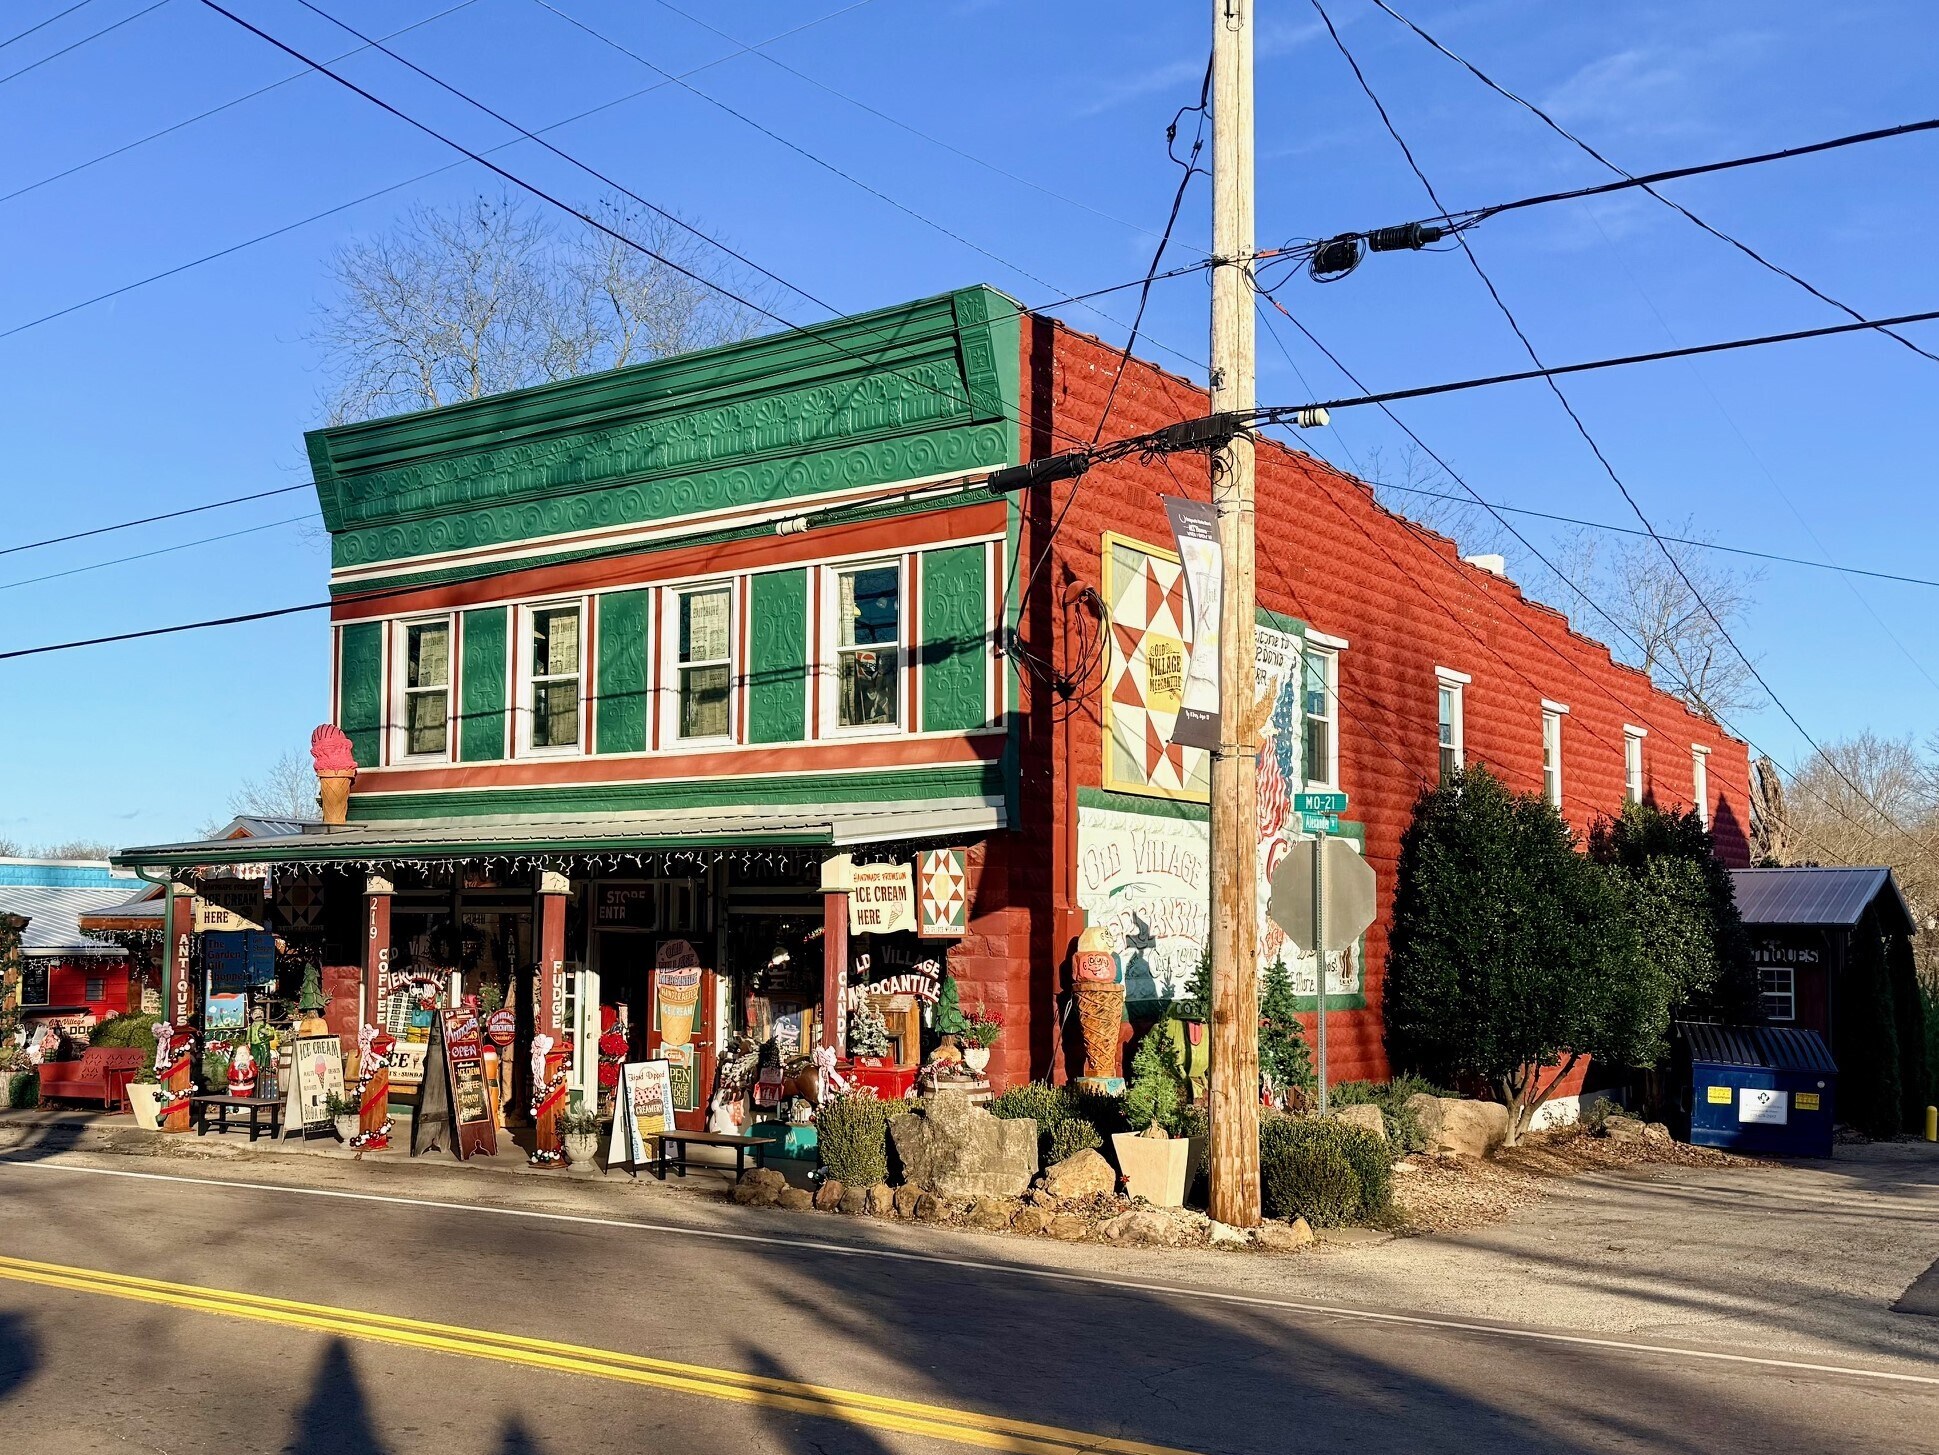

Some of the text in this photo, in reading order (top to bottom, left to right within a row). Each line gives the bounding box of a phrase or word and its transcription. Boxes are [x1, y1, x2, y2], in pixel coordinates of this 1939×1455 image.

[1155, 644, 1165, 656] OLD
[1149, 655, 1181, 677] VILLAGE
[1149, 676, 1181, 692] MERCANTILE
[1305, 796, 1335, 809] MO-21
[1083, 844, 1121, 890] OLD
[1131, 830, 1202, 890] VILLAGE
[854, 872, 907, 882] HANDMADE PREMIUM
[204, 893, 257, 906] ICE CREAM
[855, 886, 907, 902] ICE CREAM
[204, 911, 229, 923] HERE
[857, 909, 882, 925] HERE
[666, 942, 683, 958] OLD
[658, 954, 694, 974] VILLAGE
[881, 945, 941, 979] VILLAGE
[178, 934, 188, 1026] ANTIQUES
[377, 948, 389, 1024] COFFEE
[552, 960, 564, 1029] FUDGE
[674, 1004, 693, 1016] CREAM
[837, 971, 848, 1047] CANDY
[299, 1040, 339, 1061] ICE CREAM
[452, 1044, 477, 1058] OPEN
[670, 1068, 691, 1083] PEN
[636, 1103, 663, 1115] CREAMERY
